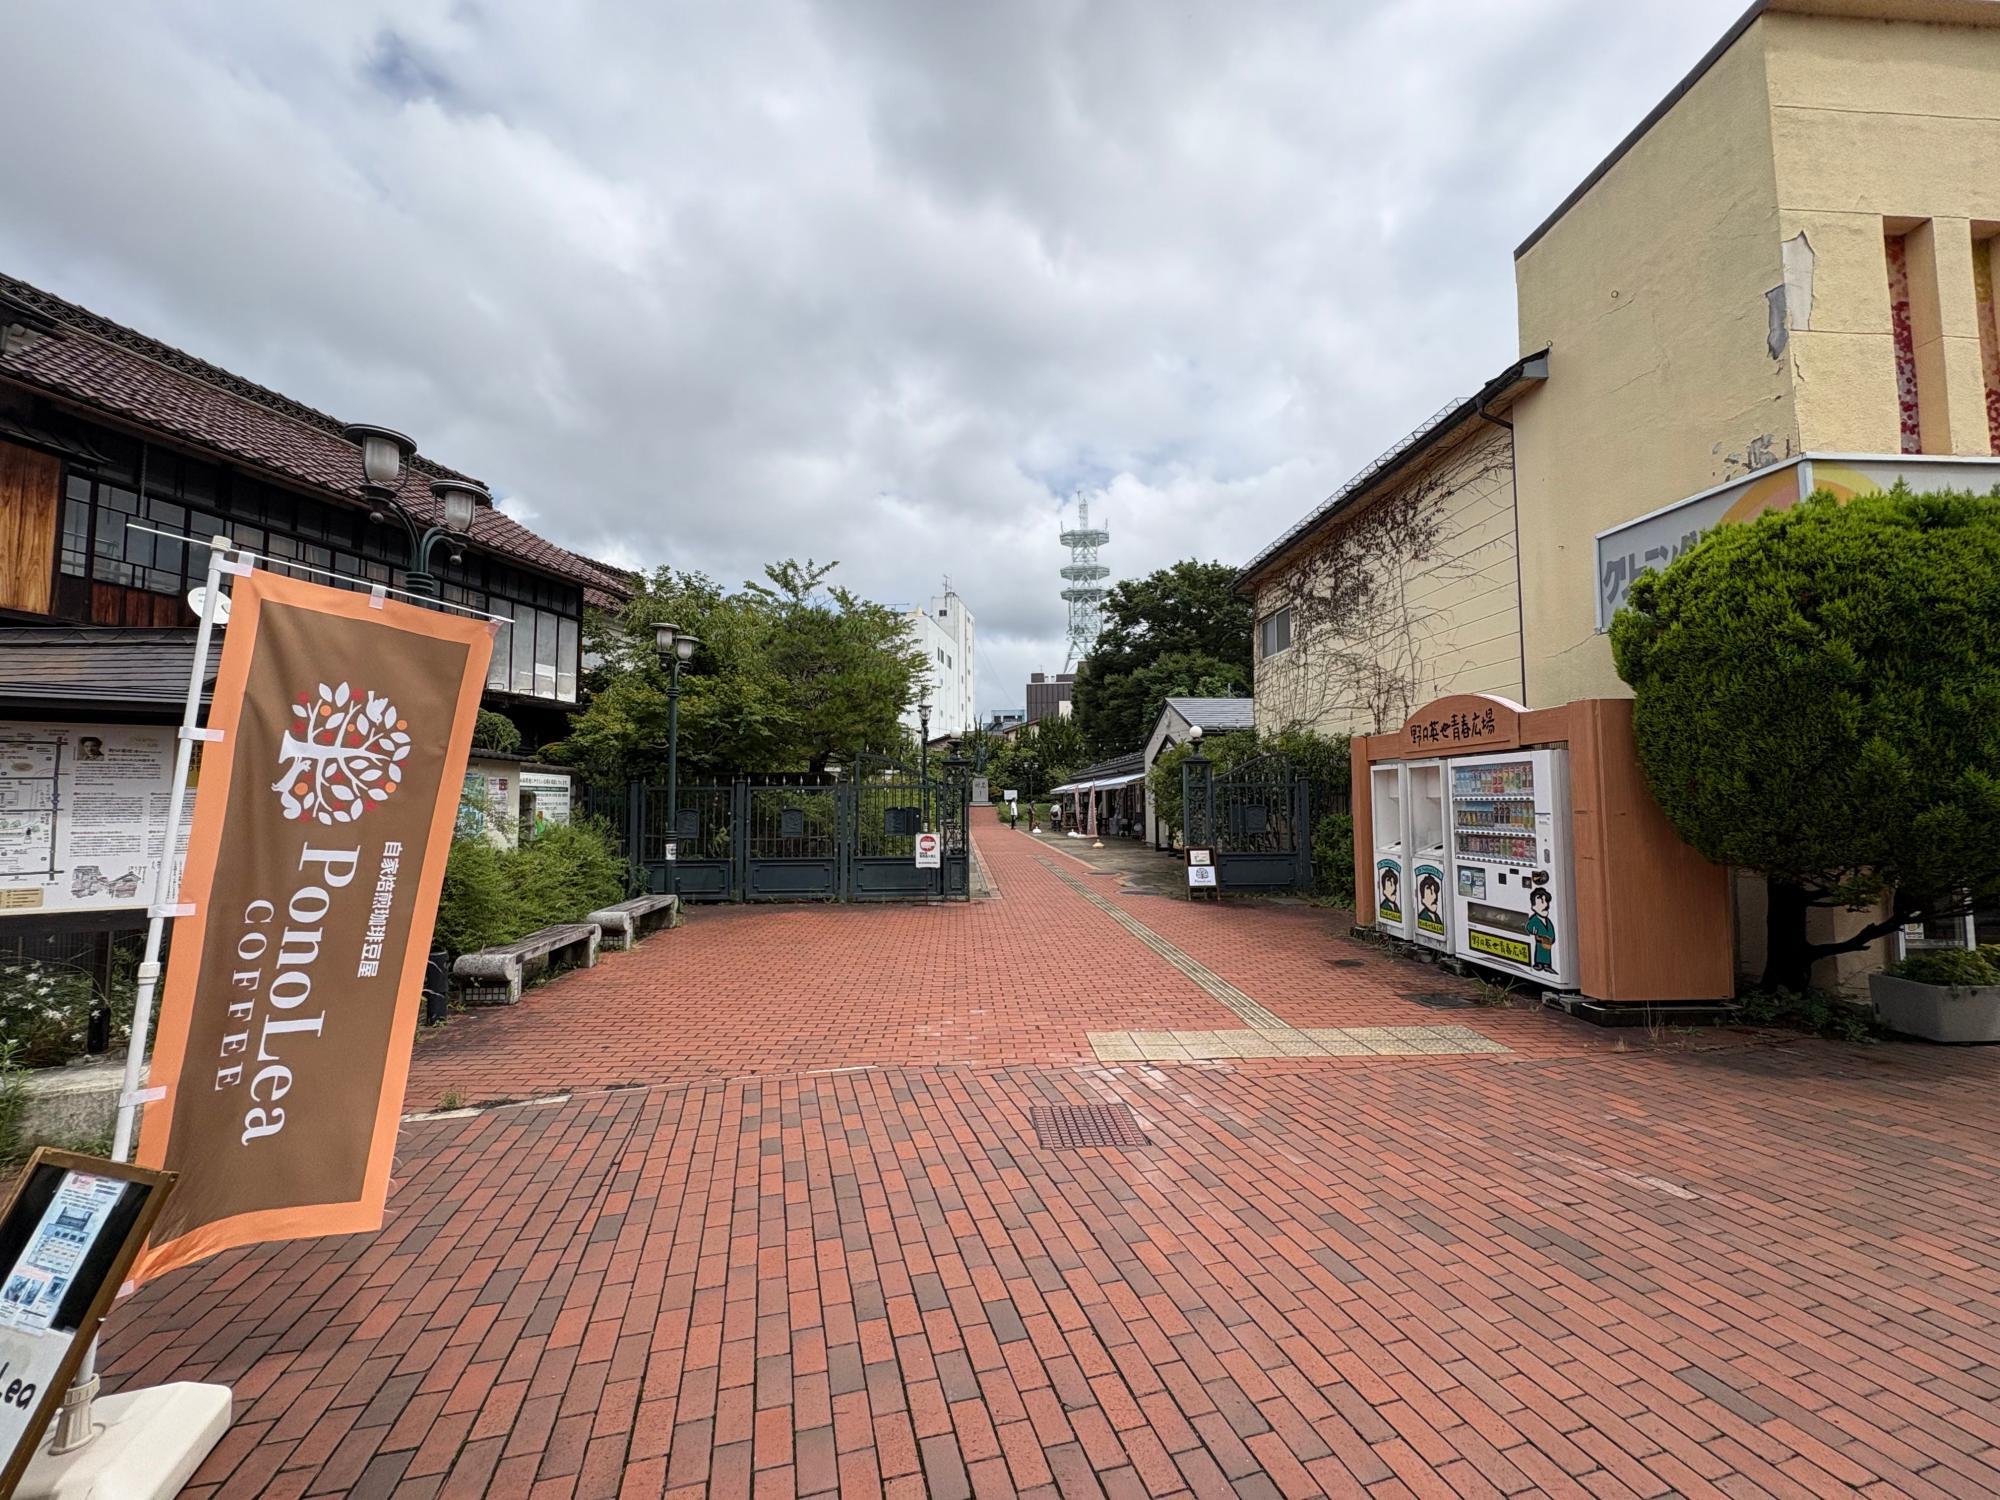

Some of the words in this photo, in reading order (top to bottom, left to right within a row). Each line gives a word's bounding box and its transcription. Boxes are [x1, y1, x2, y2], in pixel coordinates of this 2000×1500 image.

[214, 899, 275, 1092] COFFEE
[240, 841, 361, 1147] PonoLea
[357, 841, 403, 978] 自家焙煎珈琲豆屋
